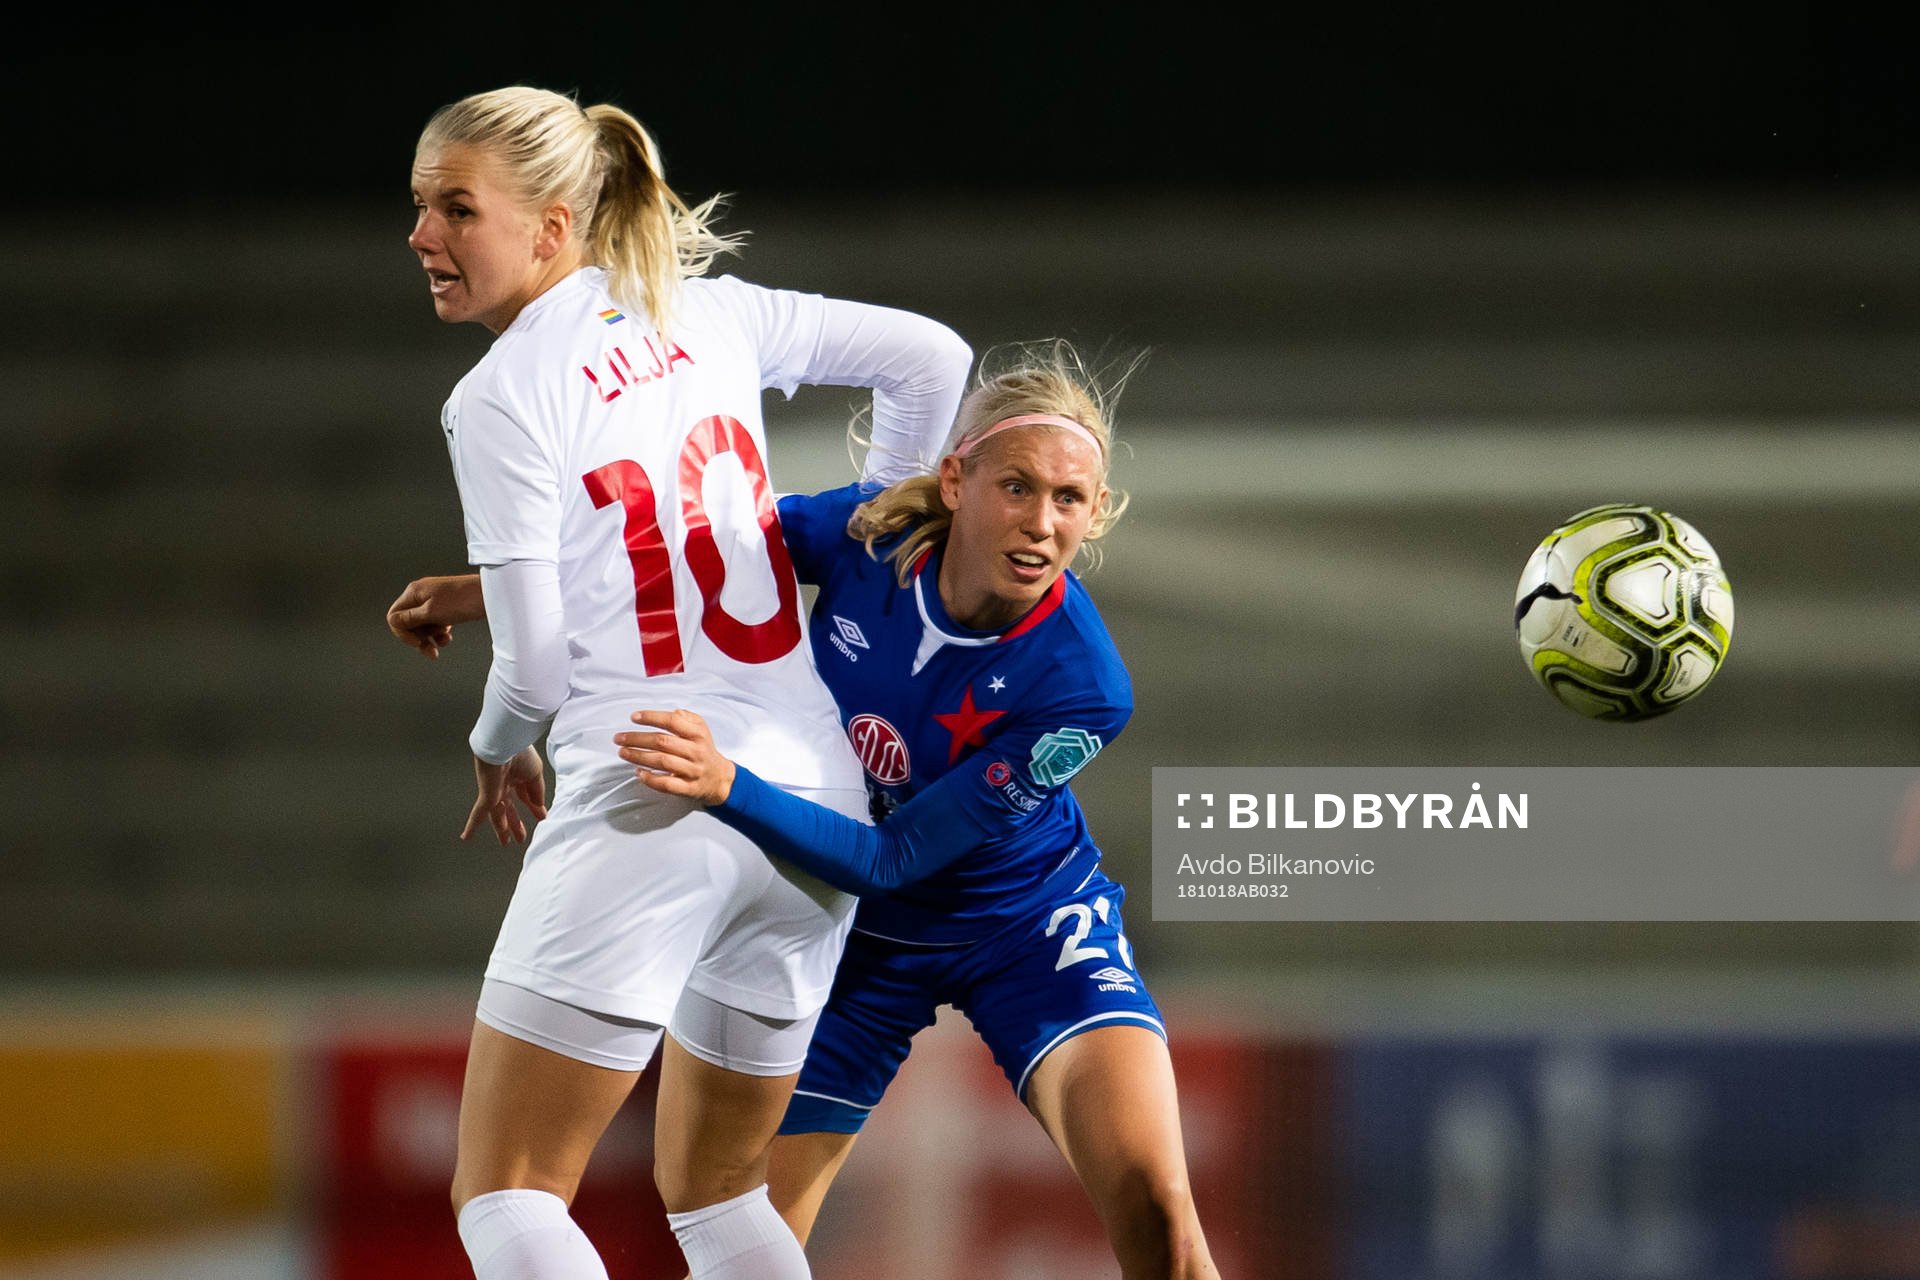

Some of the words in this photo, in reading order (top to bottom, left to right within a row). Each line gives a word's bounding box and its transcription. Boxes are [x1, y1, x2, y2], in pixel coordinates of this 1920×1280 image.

[582, 331, 695, 403] LILJA
[582, 415, 802, 678] 10
[829, 632, 858, 663] umbro
[1098, 982, 1137, 995] umbro
